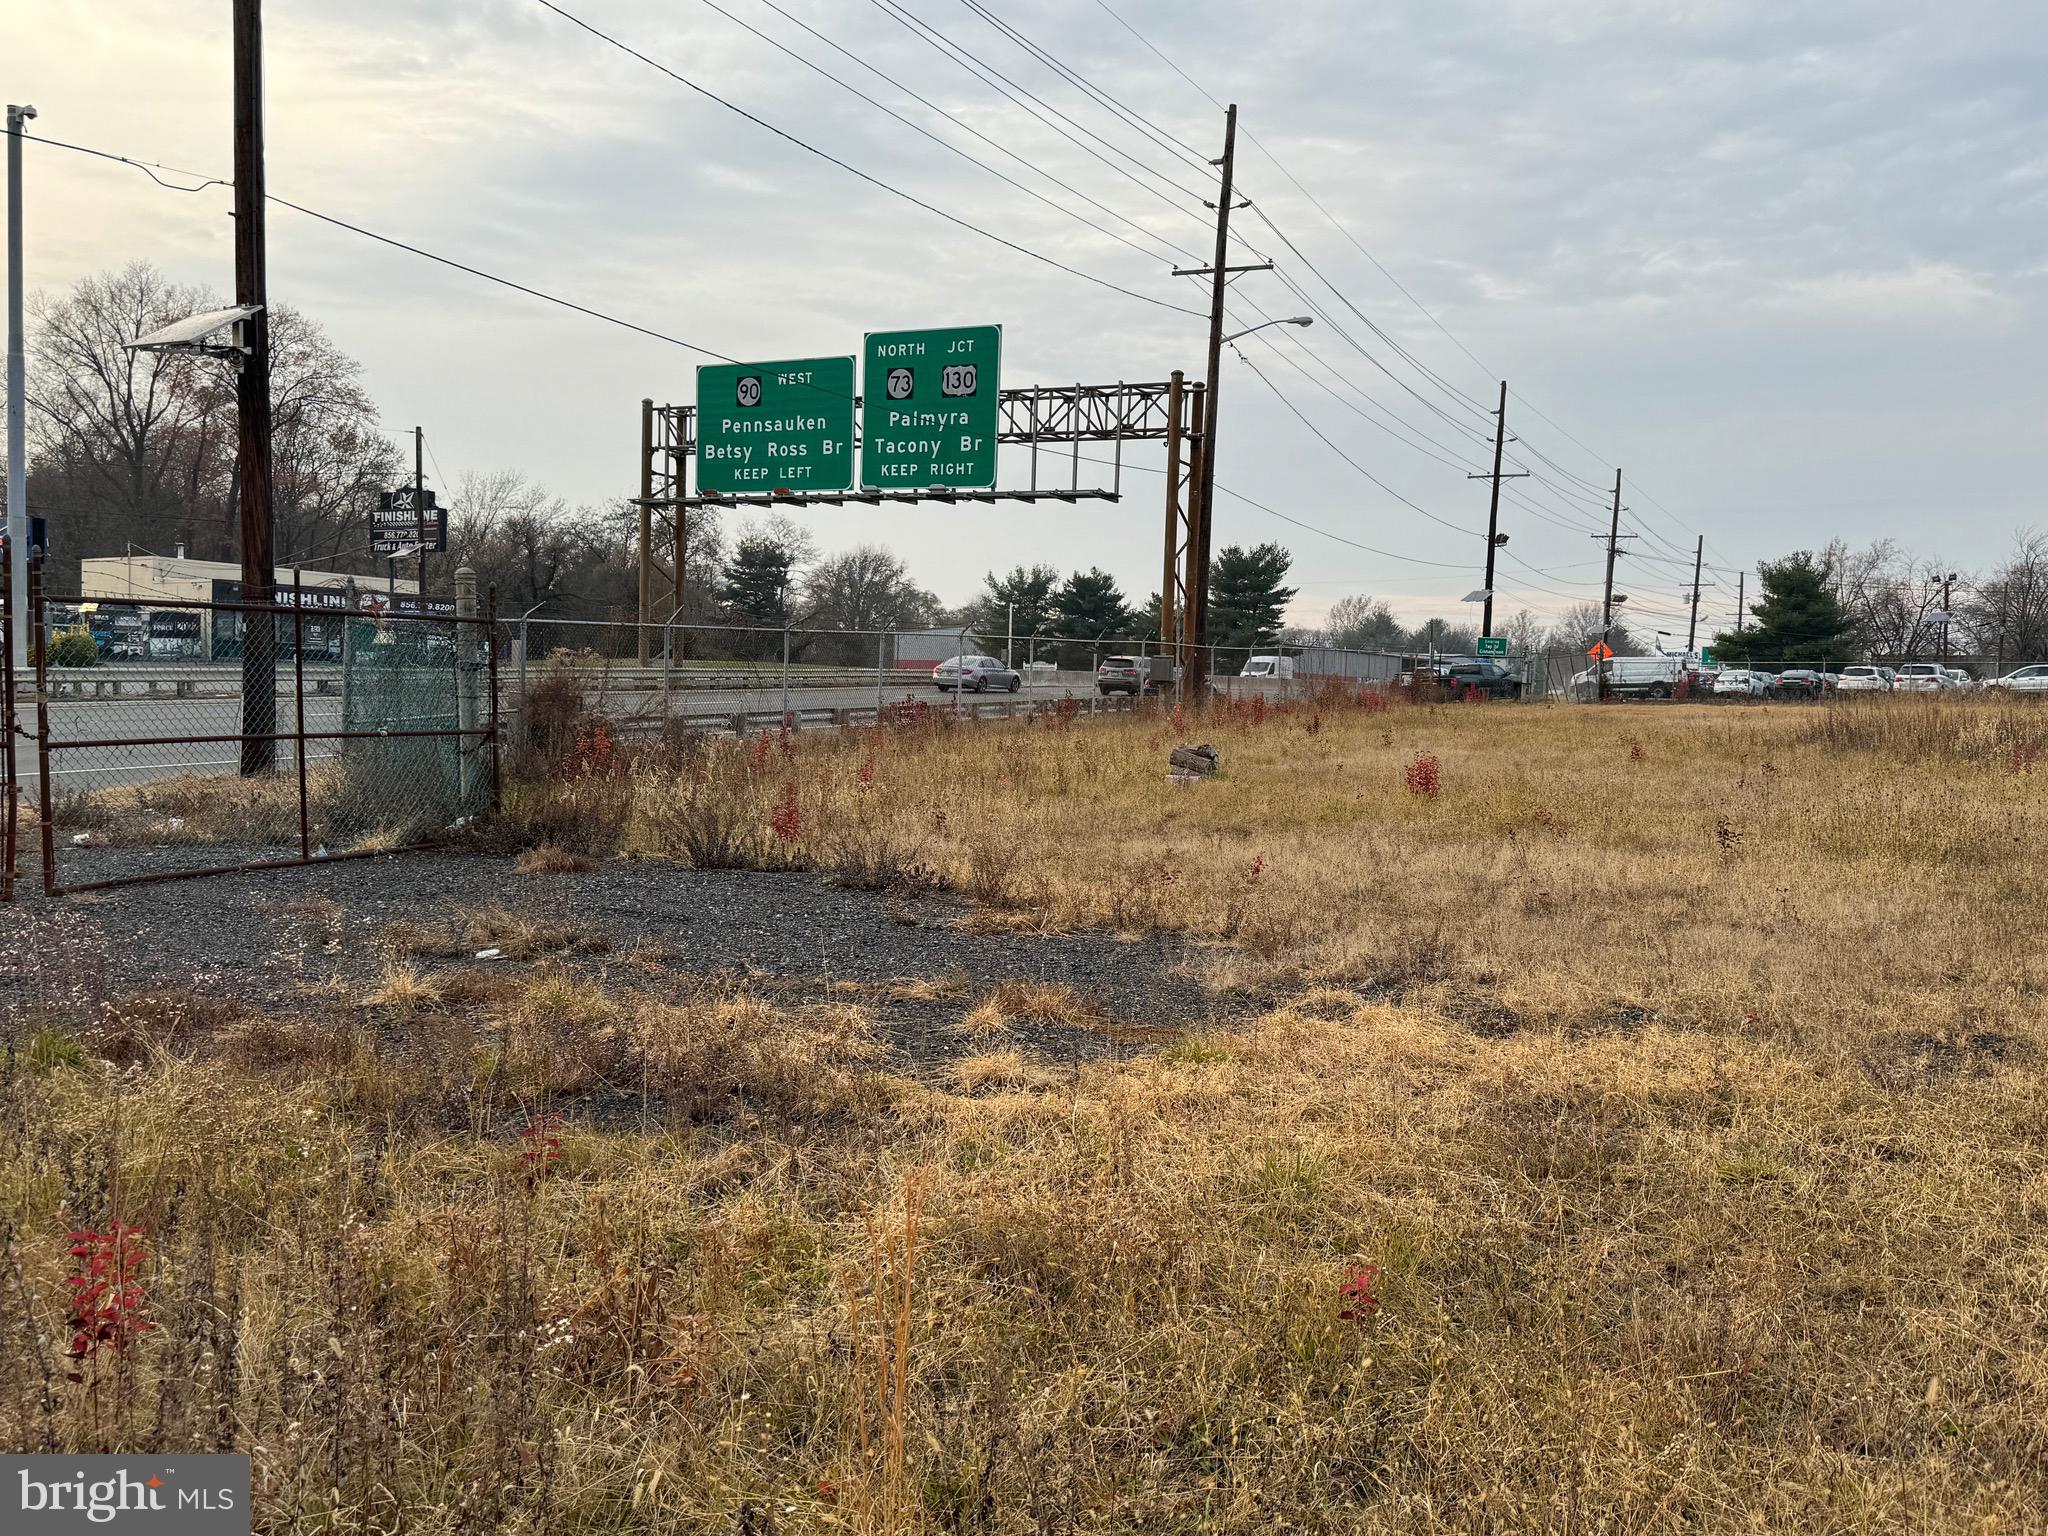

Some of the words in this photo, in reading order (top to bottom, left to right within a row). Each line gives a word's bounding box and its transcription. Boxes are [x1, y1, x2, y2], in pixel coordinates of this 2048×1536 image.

[878, 343, 925, 357] NORTH
[947, 340, 975, 353] JCT
[778, 372, 812, 385] WEST
[891, 375, 911, 392] 73
[945, 371, 974, 388] 130
[739, 383, 759, 400] 90
[722, 416, 826, 433] Pennsauken
[889, 411, 969, 431] Palmyra
[705, 444, 753, 463] Betsy
[768, 442, 807, 457] Ross
[823, 440, 843, 455] Br
[875, 438, 941, 458] Tacony
[961, 435, 983, 451] Br
[734, 468, 768, 480] KEEP
[779, 466, 812, 479] LEFT
[881, 464, 918, 476] KEEP
[930, 462, 974, 475] RIGHT
[372, 509, 438, 522] FINISHLNE
[374, 542, 391, 551] Truck
[391, 543, 397, 551] &
[1666, 651, 1698, 659] MICHAEL'S
